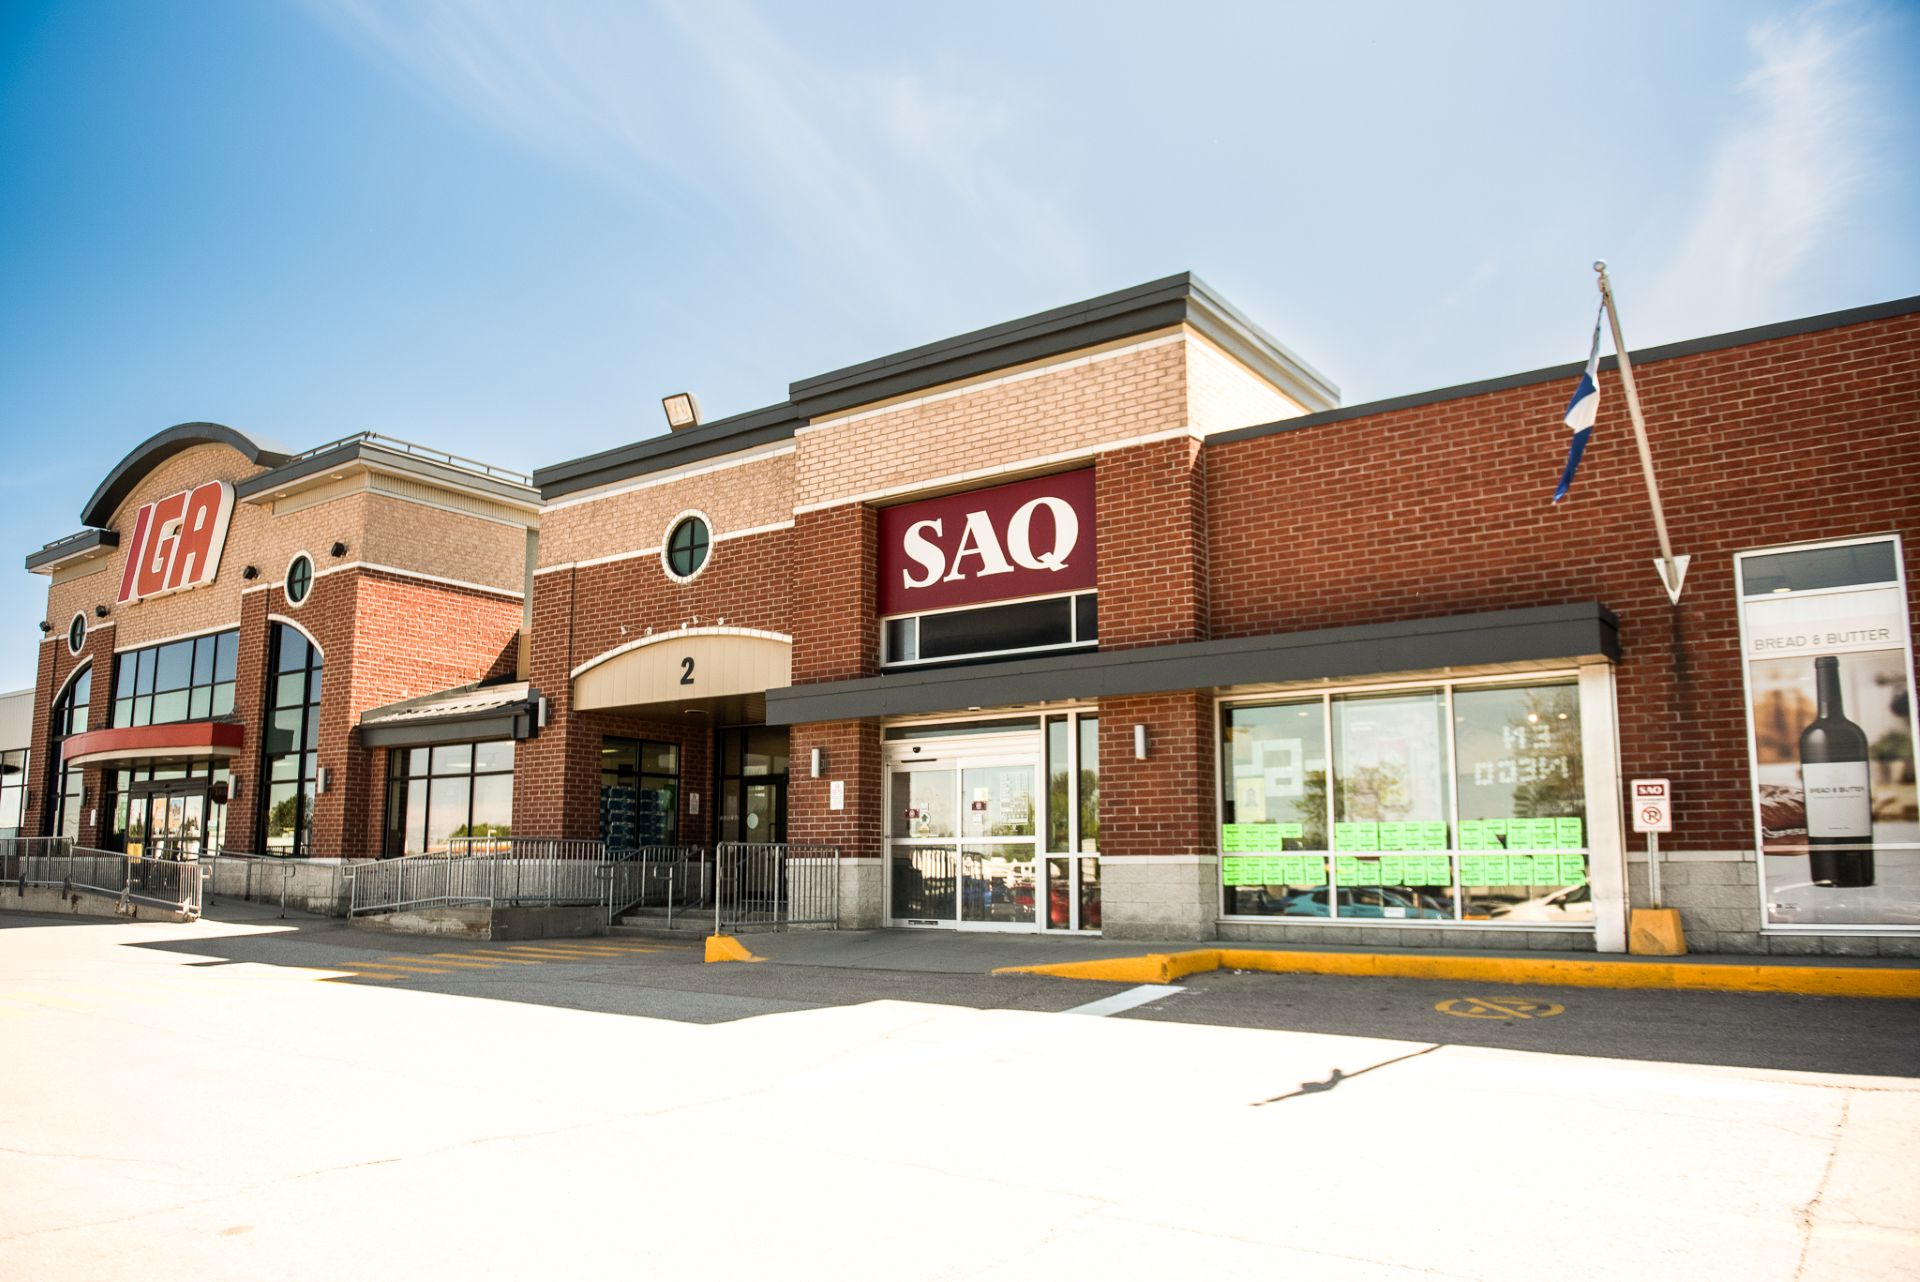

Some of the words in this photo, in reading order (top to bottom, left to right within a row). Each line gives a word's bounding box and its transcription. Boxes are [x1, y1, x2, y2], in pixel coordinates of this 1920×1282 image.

[117, 481, 222, 603] IGA
[903, 496, 1079, 589] SAQ
[1754, 635, 1807, 651] BREAD
[1812, 634, 1820, 645] &
[1827, 628, 1890, 644] BUTTER
[680, 657, 695, 685] 2
